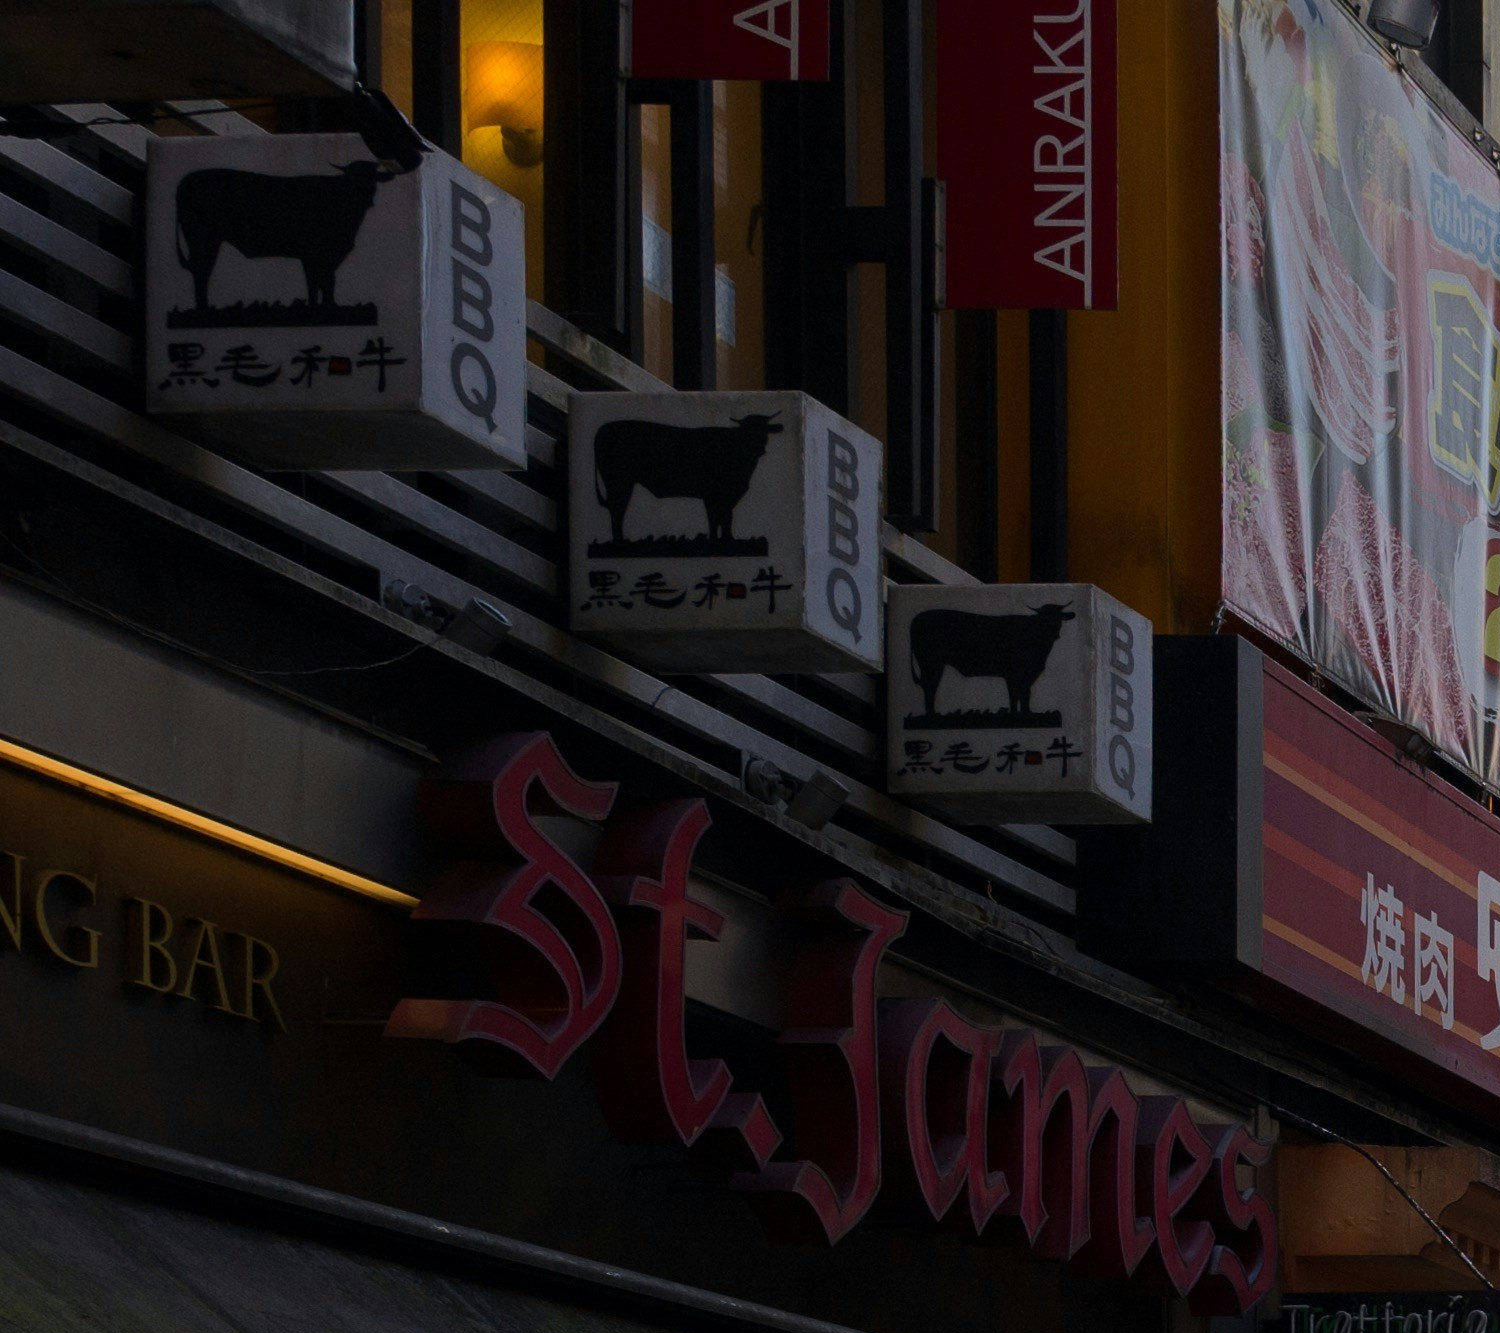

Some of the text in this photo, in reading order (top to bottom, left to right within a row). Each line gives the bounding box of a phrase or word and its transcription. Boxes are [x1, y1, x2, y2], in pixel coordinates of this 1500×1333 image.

[157, 337, 406, 392] 黒毛和牛
[449, 178, 499, 436] BBQ
[581, 565, 793, 614] 黒毛和牛
[826, 429, 862, 644] BBQ
[897, 738, 1083, 778] 黒毛和牛
[1109, 613, 1136, 799] BBQ
[1361, 870, 1455, 1032] 焼肉
